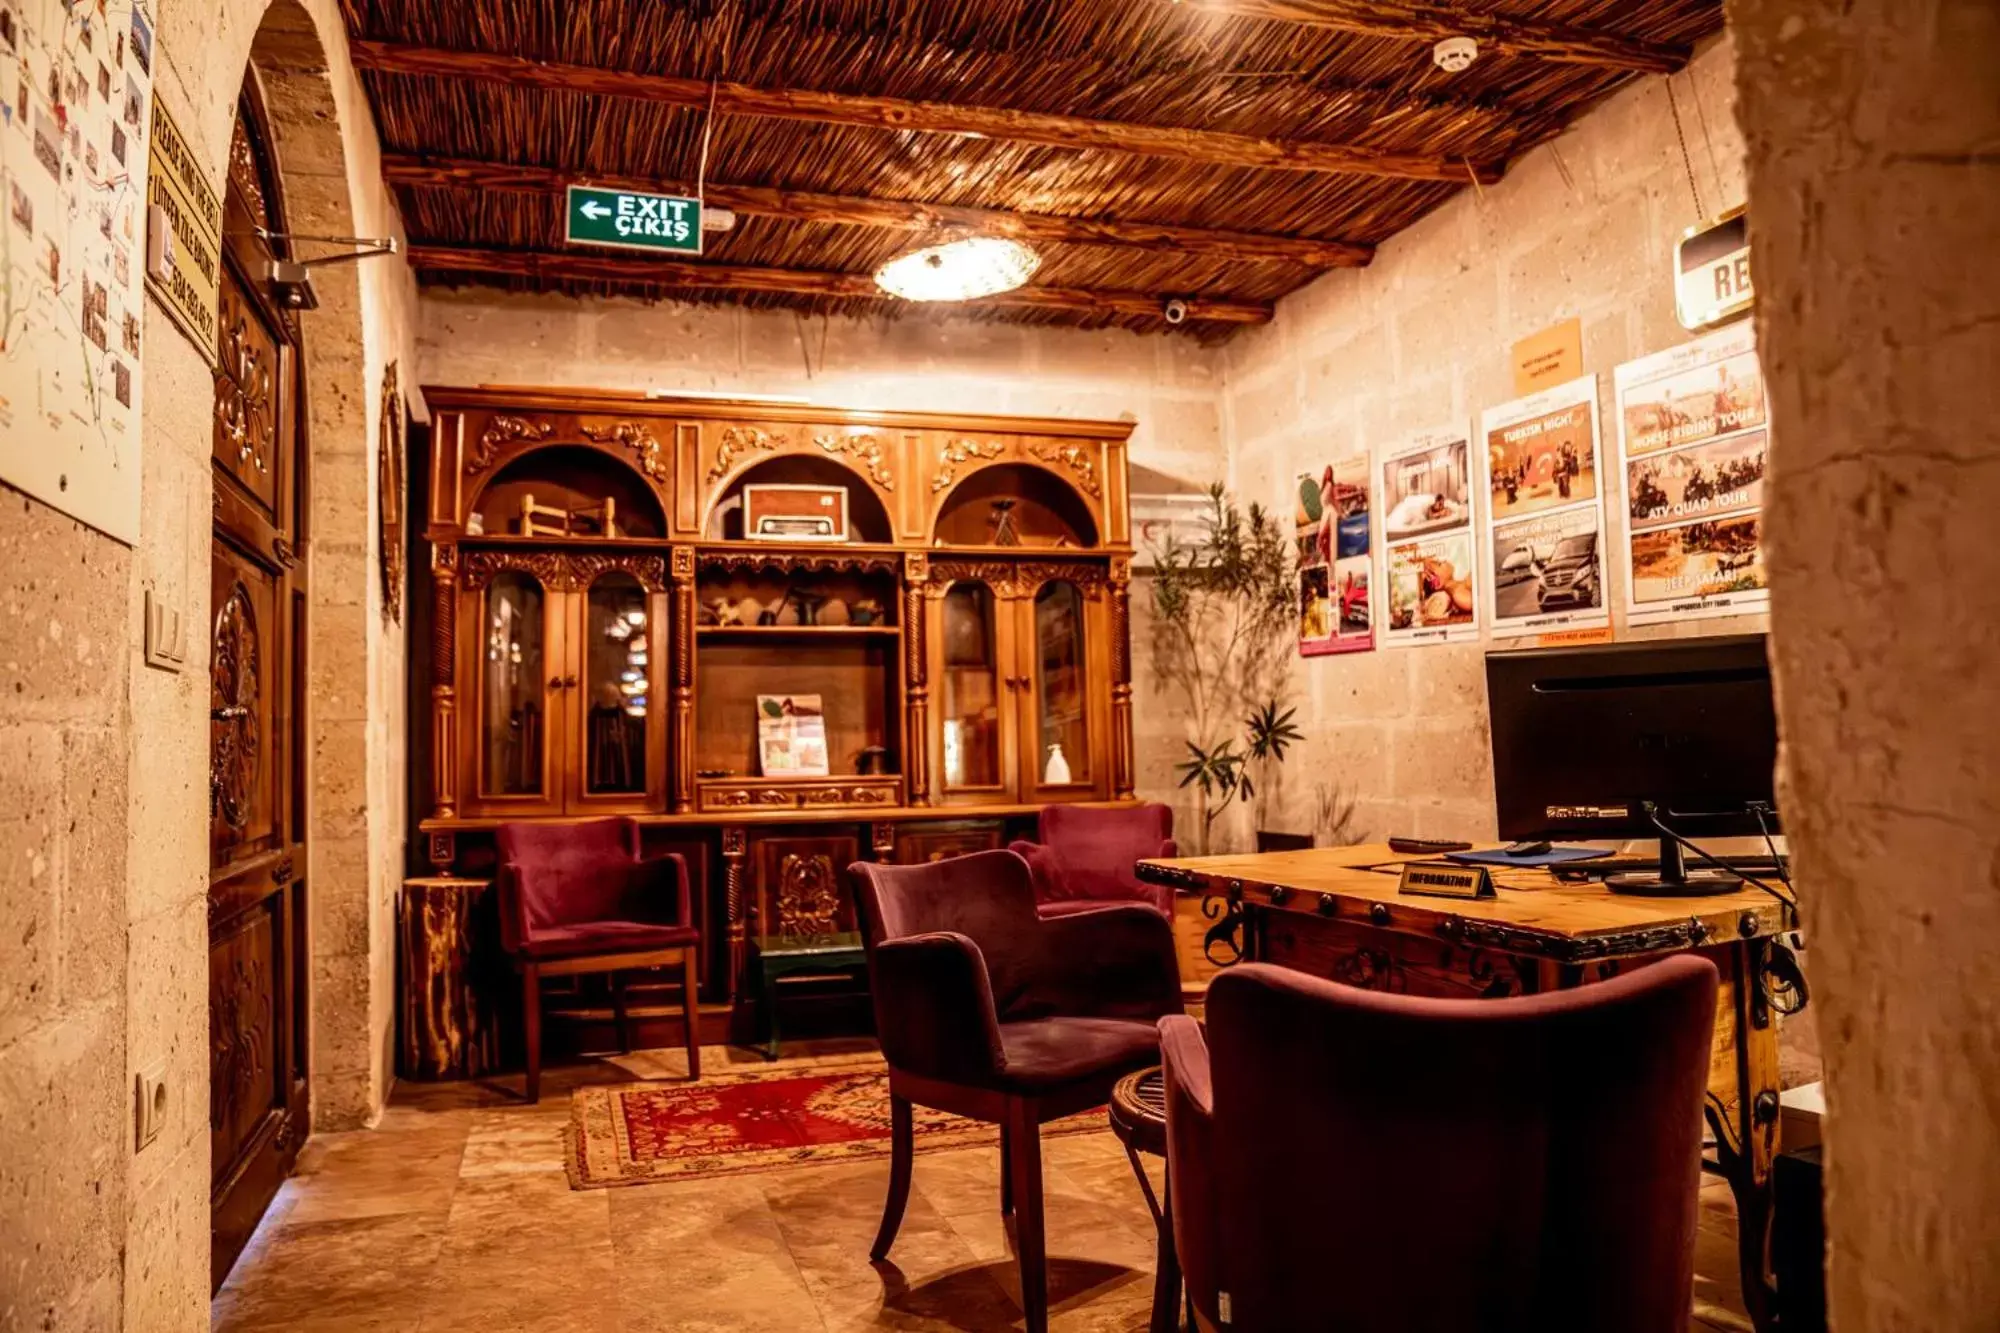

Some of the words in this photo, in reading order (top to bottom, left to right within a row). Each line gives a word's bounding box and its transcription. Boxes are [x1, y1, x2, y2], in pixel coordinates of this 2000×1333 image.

[154, 106, 179, 171] PLEASE
[180, 149, 194, 197] RING
[195, 174, 206, 216] THE
[207, 194, 218, 237] BELL
[154, 169, 179, 234] LÜTFEN
[617, 195, 689, 221] EXIT
[615, 215, 689, 242] ÇIKIŞ
[206, 311, 213, 343] 22
[1503, 423, 1541, 443] TURKISH
[1543, 411, 1573, 432] NIGHT
[1673, 416, 1716, 438] RIDING
[1719, 405, 1755, 427] TOUR
[1647, 504, 1669, 521] ATV
[1673, 495, 1710, 517] QUAD
[1713, 488, 1749, 508] TOUR
[1693, 568, 1737, 586] SAFARI
[1408, 872, 1473, 888] INFORMATION
